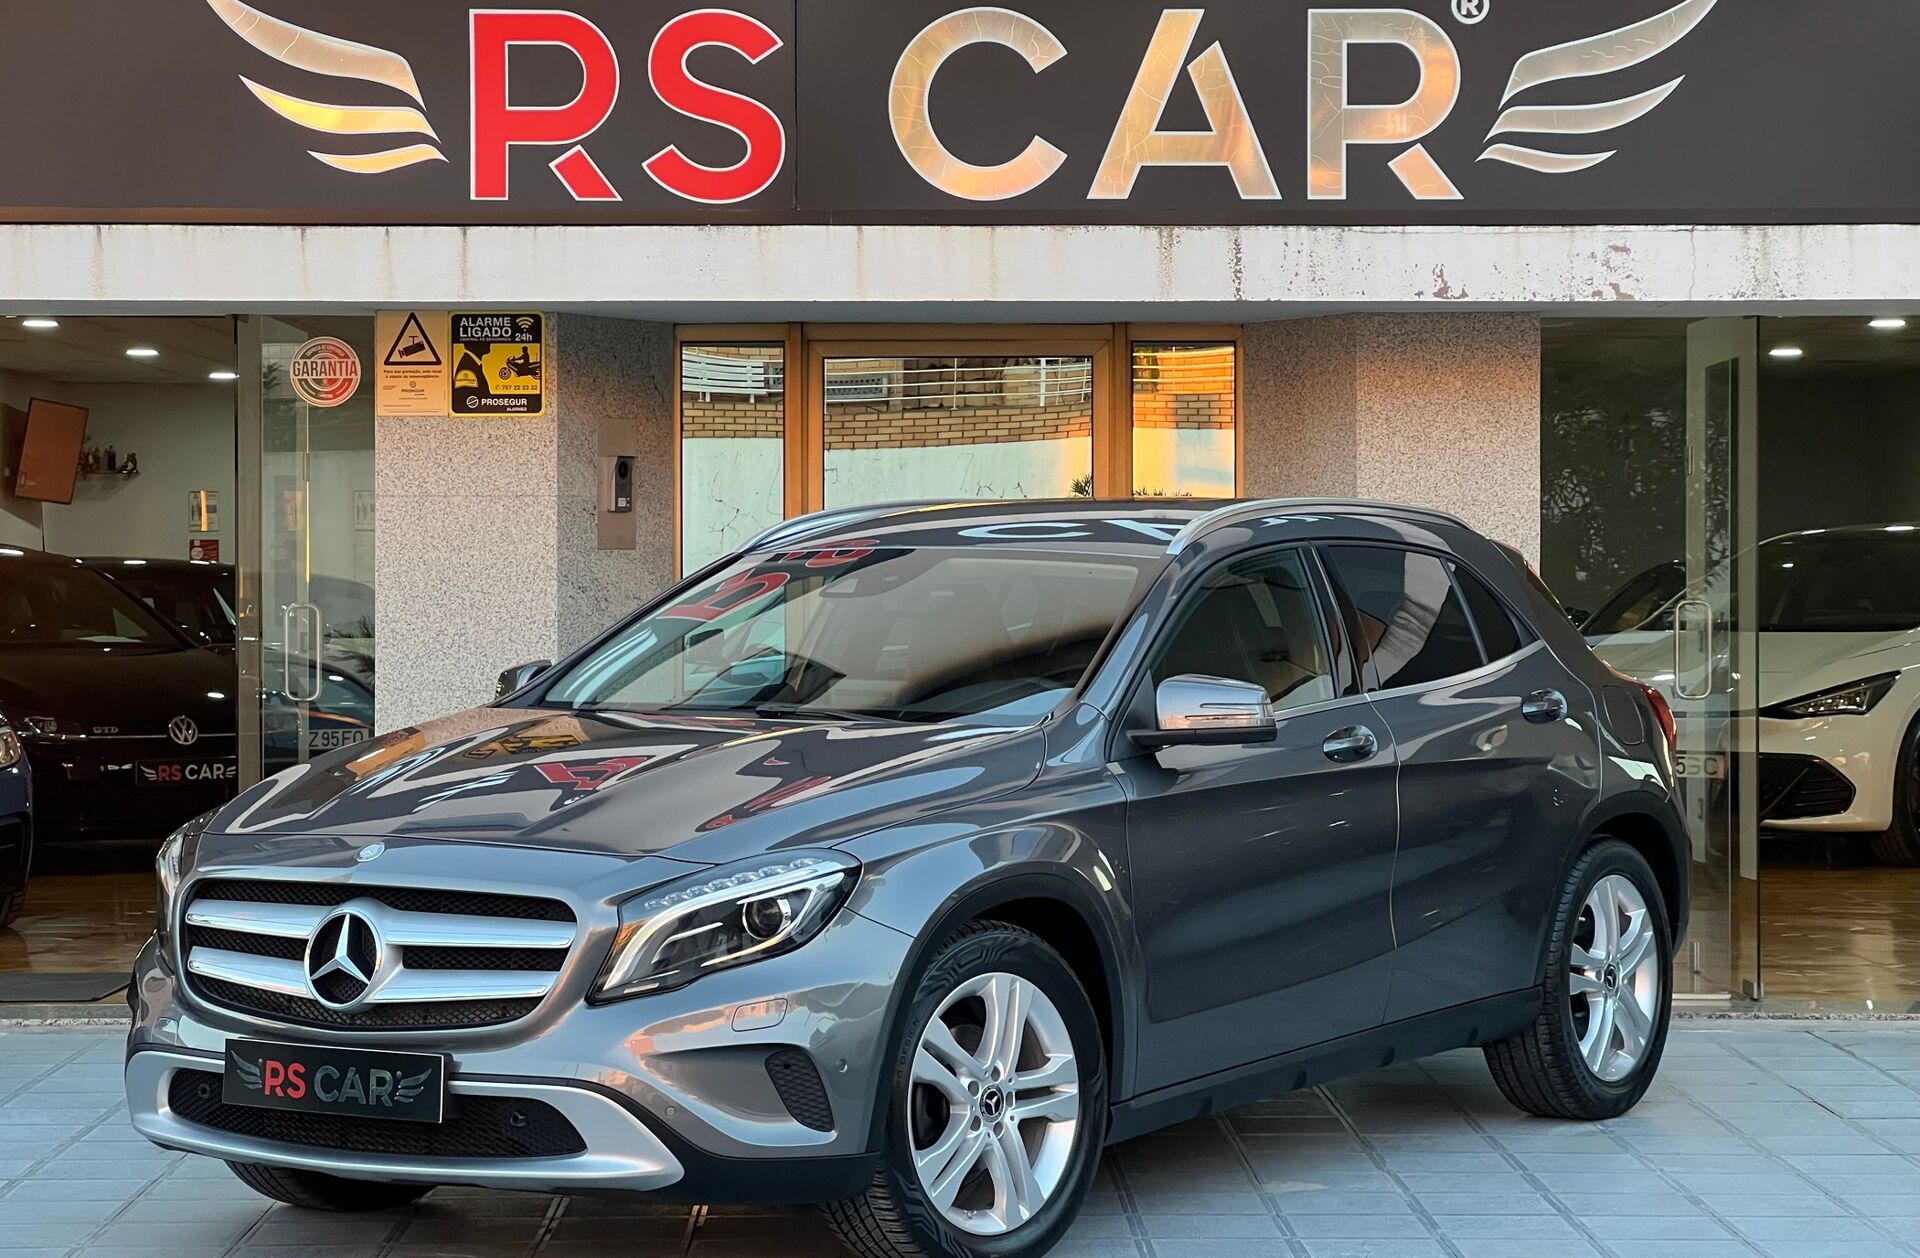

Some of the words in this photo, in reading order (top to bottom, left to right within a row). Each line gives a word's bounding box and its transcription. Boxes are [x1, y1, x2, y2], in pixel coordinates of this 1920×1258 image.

[469, 8, 786, 205] RS
[888, 6, 1465, 202] CAR
[460, 316, 512, 327] ALARME
[460, 327, 512, 337] LIGADO
[515, 333, 533, 341] 24h
[293, 360, 358, 377] GARANTIA
[481, 398, 528, 406] PROSEGUR
[92, 726, 119, 734] GTD
[158, 764, 183, 782] RS
[185, 763, 225, 780] CAR
[263, 1059, 307, 1100] RS
[313, 1064, 394, 1107] CAR
